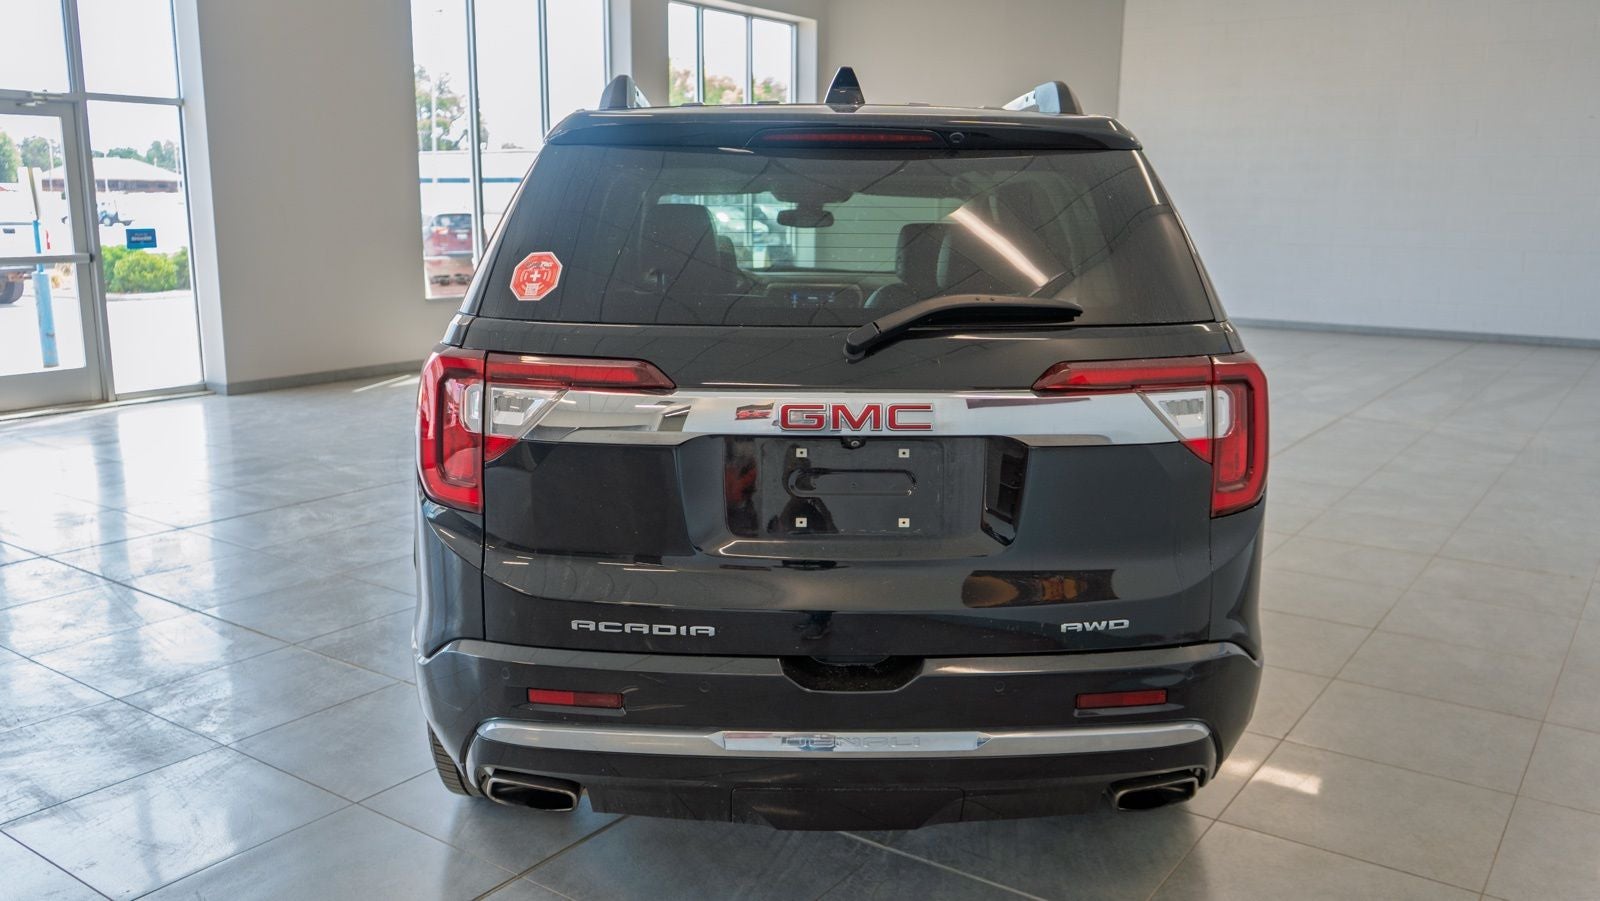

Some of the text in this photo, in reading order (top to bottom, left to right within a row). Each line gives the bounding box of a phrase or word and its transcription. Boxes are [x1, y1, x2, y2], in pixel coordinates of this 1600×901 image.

[779, 403, 933, 431] GMC
[570, 619, 717, 637] ACADIA
[1060, 619, 1130, 633] AWD
